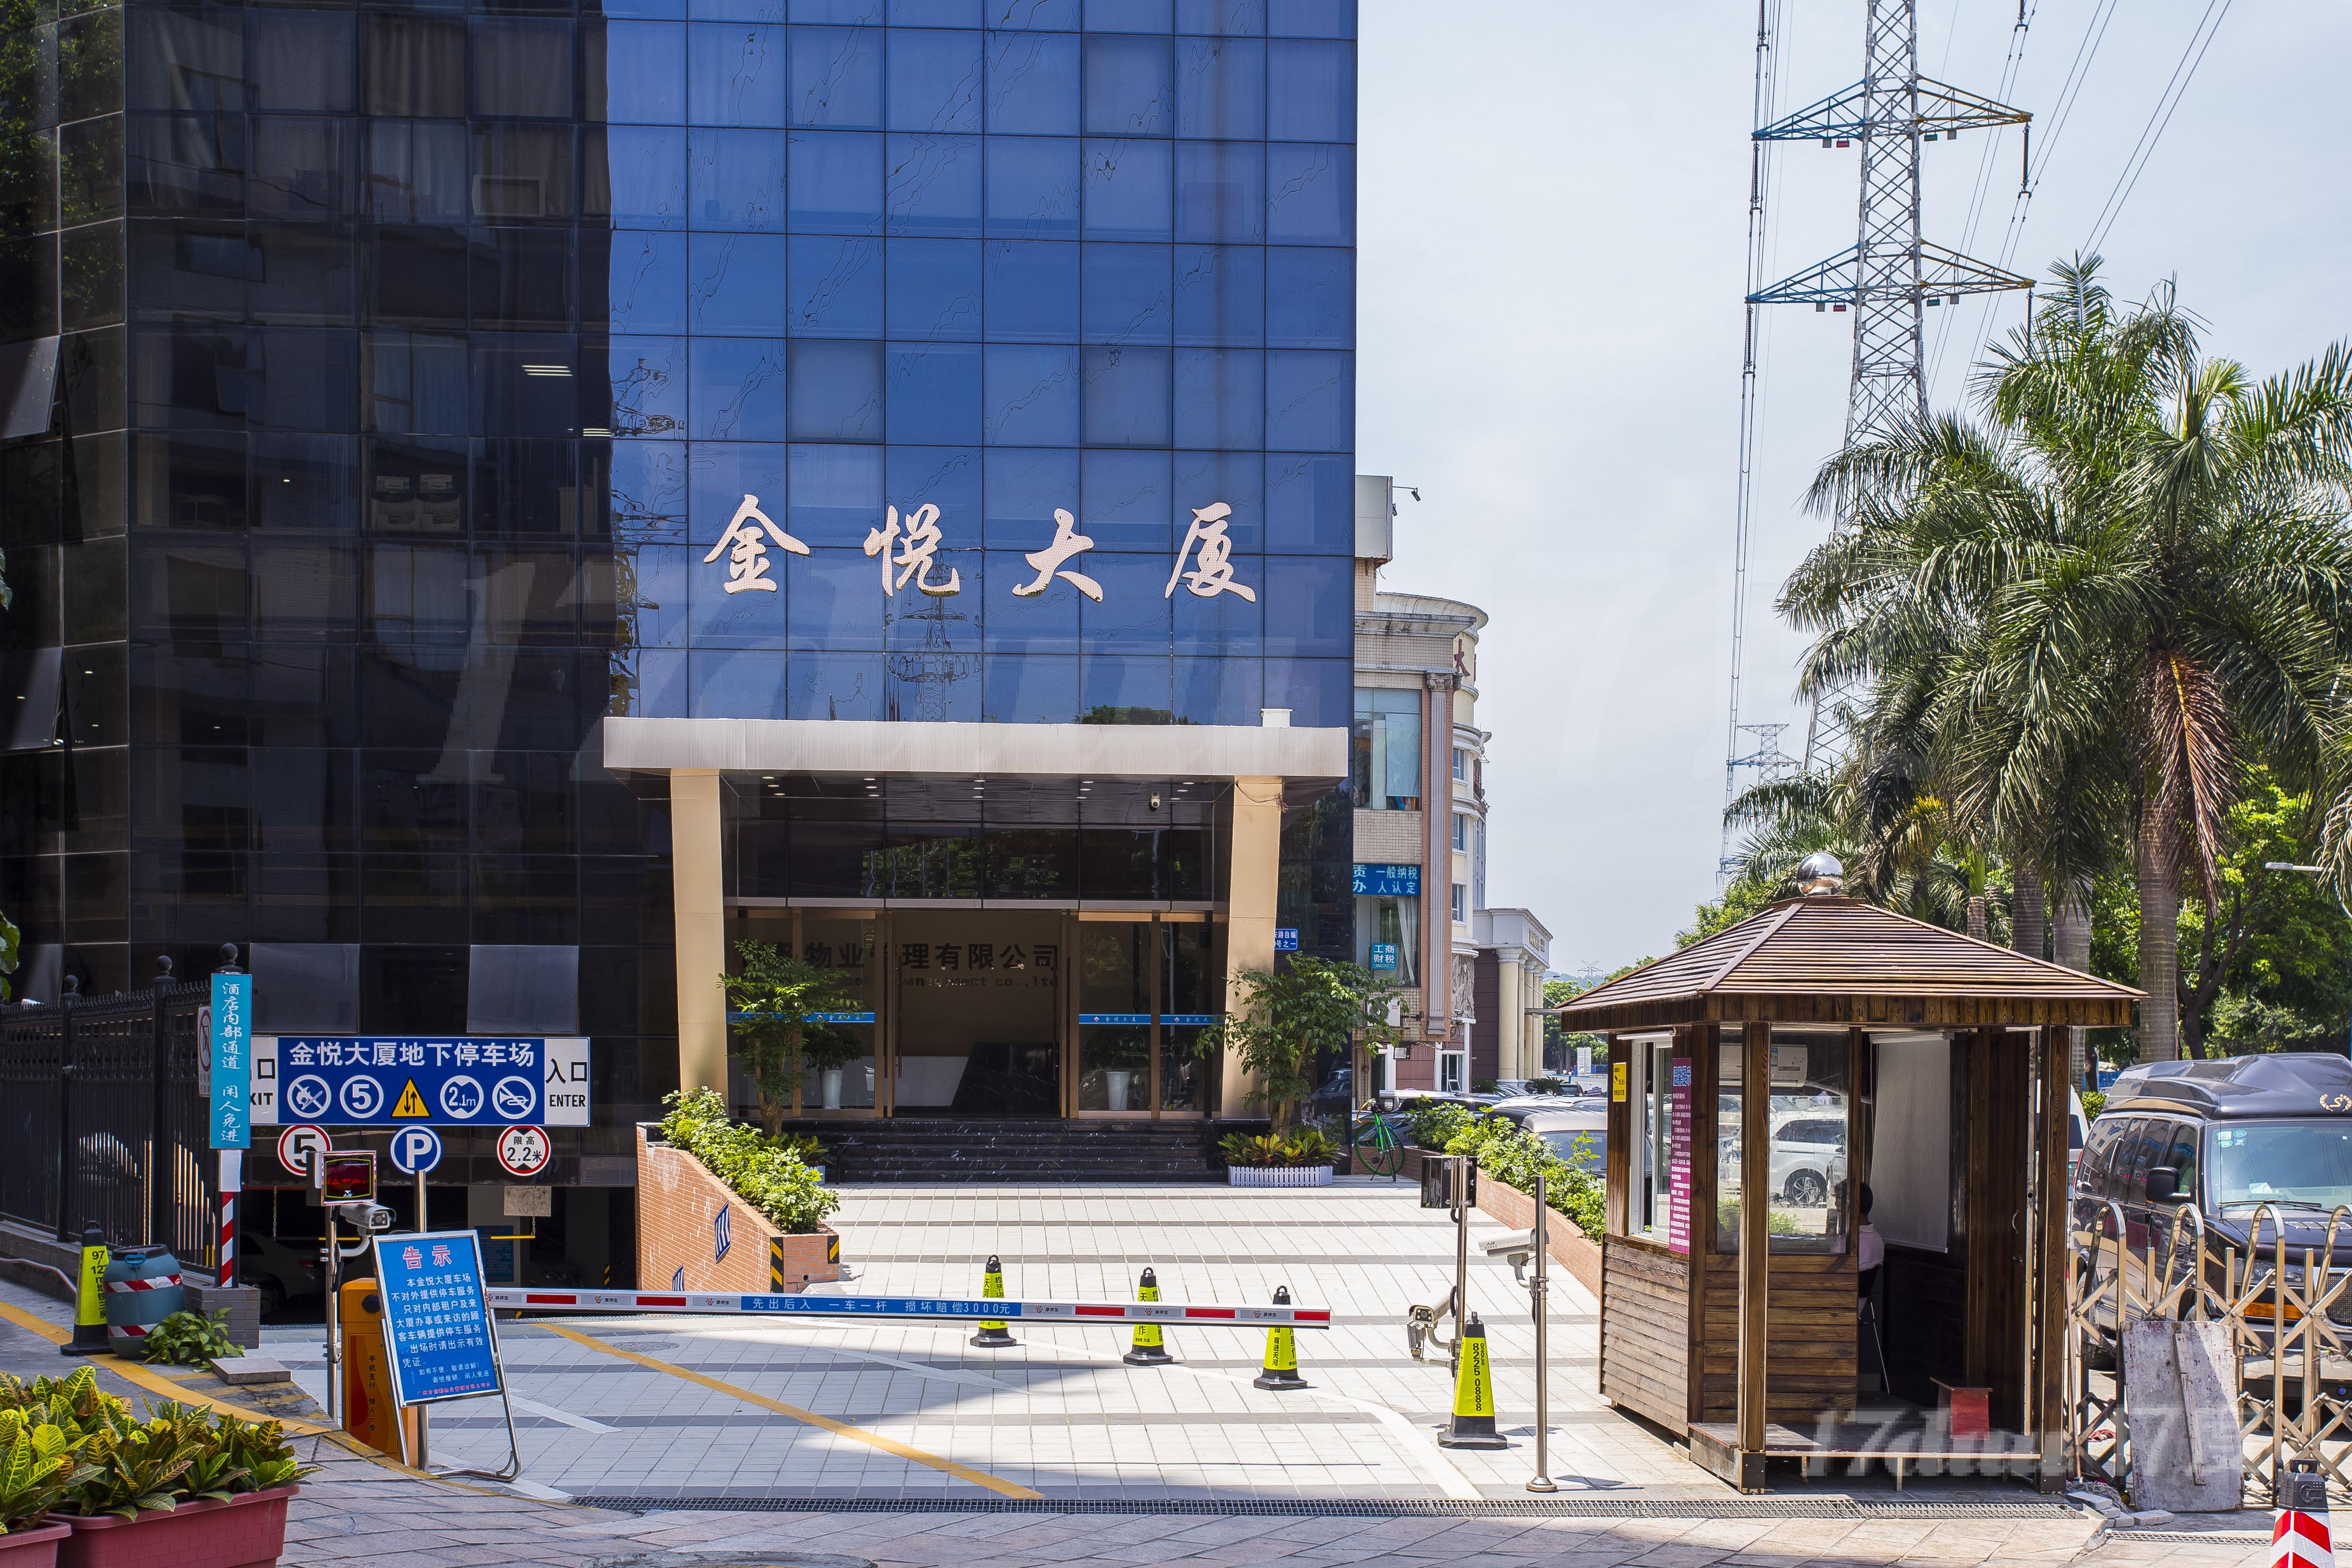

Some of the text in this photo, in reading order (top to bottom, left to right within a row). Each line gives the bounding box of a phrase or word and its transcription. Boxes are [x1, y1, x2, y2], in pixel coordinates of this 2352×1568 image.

[704, 494, 1256, 603] 金悦大厦
[1376, 866, 1418, 879] 一般纳税
[1378, 881, 1415, 894] 人认定
[1373, 945, 1395, 953] 工商
[1373, 954, 1395, 964] 财税
[218, 982, 243, 1142] 酒店内部通道 闲人免进
[289, 1041, 535, 1067] 金悦大厦地下停车场
[546, 1058, 588, 1084] 入口
[251, 1092, 274, 1106] XIT
[352, 1084, 371, 1106] 5
[448, 1087, 476, 1107] 2.1m
[549, 1094, 586, 1108] ENTER
[513, 1136, 535, 1145] 限高
[407, 1138, 431, 1168] P
[507, 1146, 542, 1162] 2.2米
[92, 1250, 105, 1260] 97
[402, 1244, 453, 1270] 告示
[406, 1273, 472, 1287] 本金悦大厦车场
[983, 1278, 990, 1298] 天河
[391, 1285, 475, 1302] 不对外提供停车服务
[753, 1298, 1011, 1314] 先出后入 一车一杆 损坏赔偿3000元
[395, 1311, 480, 1329] 大厦办事或来访的顾
[398, 1324, 481, 1342] 客车辆提供停车服务
[1139, 1325, 1146, 1335] 作
[1272, 1337, 1280, 1366] 首进天河
[368, 1355, 377, 1432] 手机支付 快人一步
